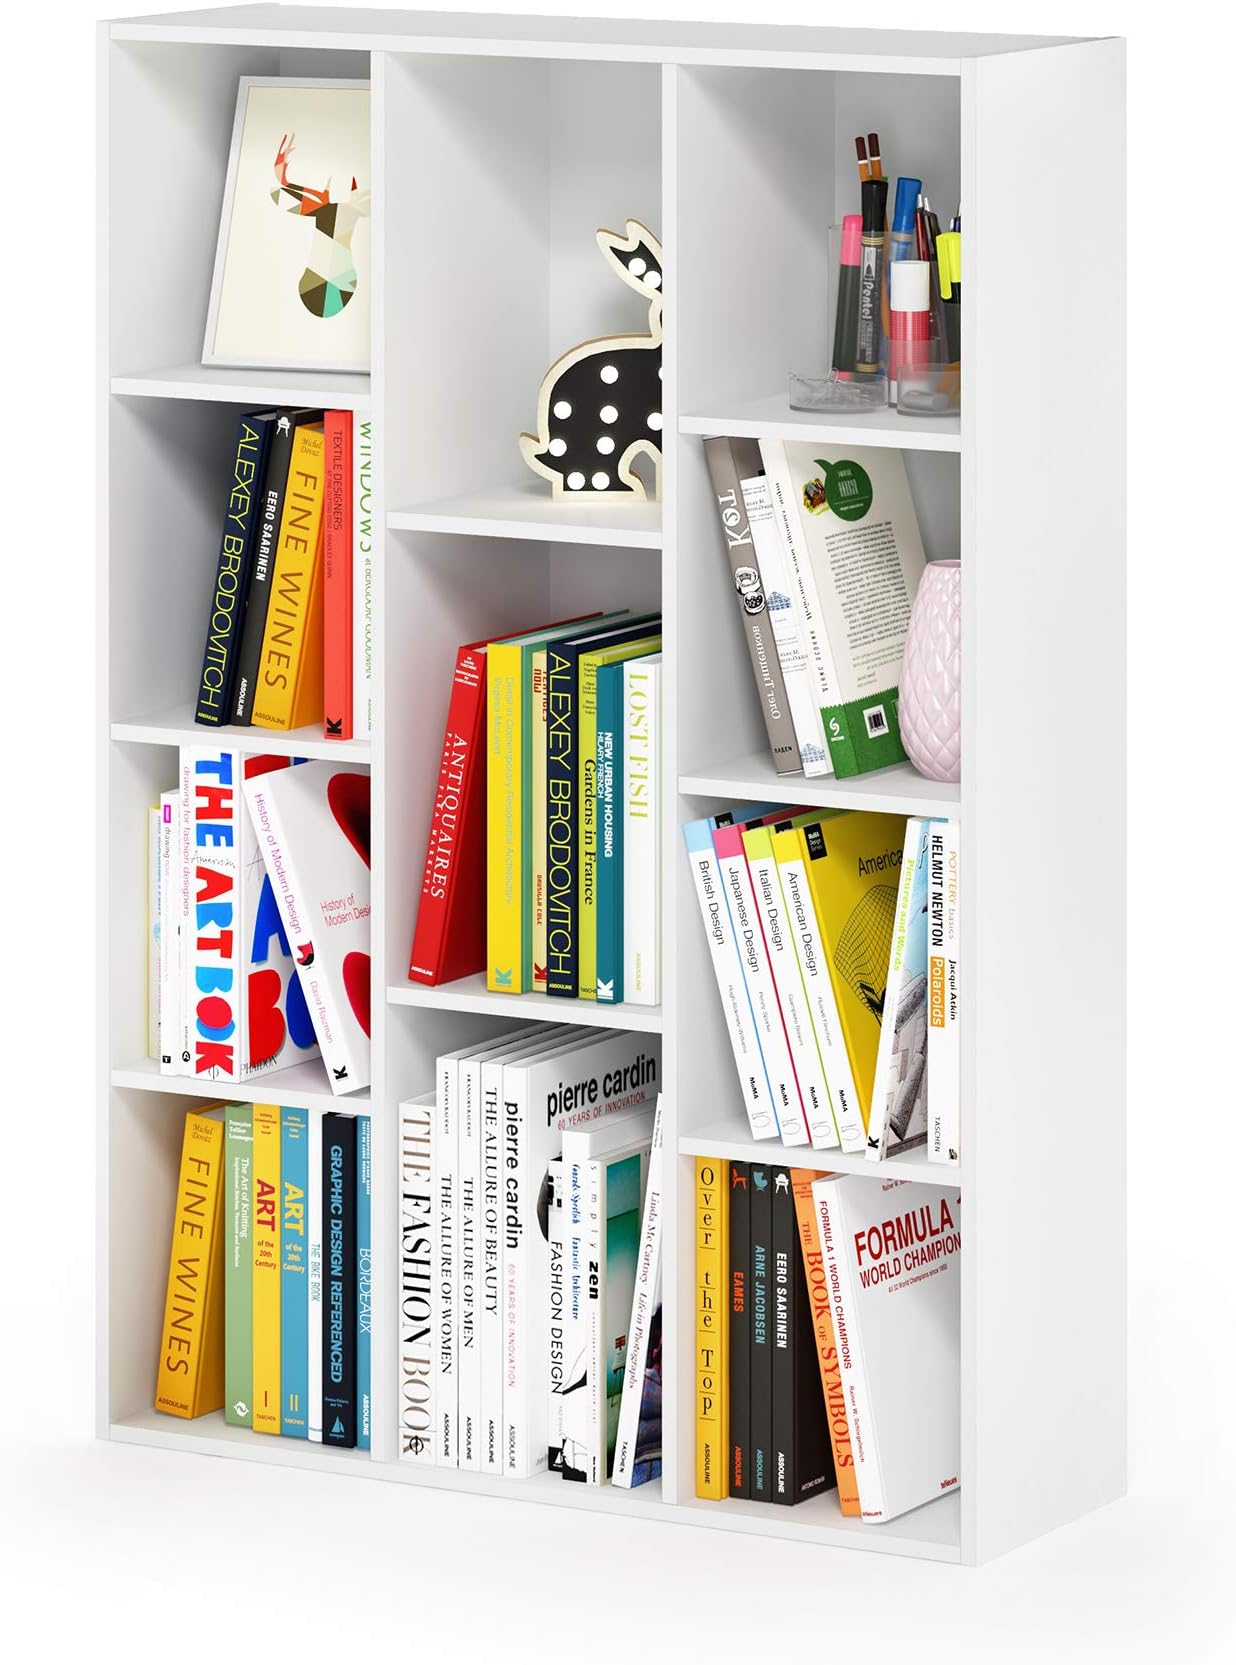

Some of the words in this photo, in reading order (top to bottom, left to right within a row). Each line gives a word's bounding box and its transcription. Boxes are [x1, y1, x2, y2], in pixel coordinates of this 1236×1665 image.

[862, 281, 874, 320] Pentel
[228, 423, 260, 530] ALEXEY
[333, 431, 342, 470] TEXTILE
[264, 490, 278, 525] EERO
[285, 470, 318, 554] FINE
[333, 473, 342, 530] DESIGNERS
[256, 528, 274, 582] SAARINEN
[200, 534, 244, 708] BRODOVITCH
[264, 572, 303, 690] WINES
[254, 712, 286, 726] ASSOULINE
[550, 652, 571, 770] ALEXEY
[629, 674, 648, 747] LOST
[604, 732, 613, 759] NEW
[195, 752, 233, 847] THE
[585, 759, 596, 829] Gardens
[604, 762, 613, 801] URBAN
[629, 756, 648, 818] FISH
[430, 734, 468, 899] ANTIQUAIRES
[585, 831, 596, 845] in
[604, 804, 613, 857] HOUSING
[254, 793, 271, 833] History
[267, 835, 277, 846] of
[272, 849, 289, 894] Modern
[285, 894, 302, 934] Design
[550, 780, 571, 974] BRODOVITCH
[585, 851, 596, 905] France
[902, 858, 915, 909] Pictures
[932, 835, 943, 887] HELMUT
[195, 865, 233, 959] ART
[320, 897, 347, 913] History
[347, 893, 355, 906] of
[699, 860, 715, 900] British
[708, 902, 724, 945] Design
[728, 867, 749, 927] Japanese
[744, 929, 760, 973] Design
[759, 869, 773, 905] Italian
[767, 908, 784, 951] Design
[788, 872, 808, 931] American
[801, 933, 818, 976] Design
[932, 892, 943, 947] NEWTON
[932, 958, 943, 1026] Polaroids
[949, 959, 957, 991] Jacqui
[485, 1088, 497, 1126] THE
[547, 1077, 598, 1127] pierre
[603, 1054, 656, 1098] cardin
[558, 1118, 565, 1131] 60
[568, 1110, 591, 1127] YEARS
[593, 1107, 602, 1119] OF
[605, 1091, 646, 1114] INNOVATION
[750, 1076, 759, 1099] MoMA
[780, 1084, 789, 1106] MoMA
[810, 1086, 819, 1109] MoMA
[839, 1089, 848, 1112] MoMA
[403, 1111, 431, 1182] THE
[505, 1101, 523, 1169] pierre
[330, 1145, 343, 1215] GRAPHIC
[441, 1174, 452, 1208] THE
[464, 1177, 473, 1212] THE
[485, 1131, 497, 1204] ALLURE
[181, 1157, 210, 1239] FINE
[240, 1204, 249, 1238] Knitting
[241, 1192, 249, 1201] of
[257, 1179, 275, 1232] ART
[284, 1182, 304, 1236] ART
[485, 1209, 497, 1233] OF
[506, 1178, 522, 1249] cardin
[649, 1191, 660, 1222] Linda
[701, 1167, 715, 1245] Over
[330, 1219, 343, 1276] DESIGN
[441, 1212, 452, 1278] ALLURE
[464, 1215, 473, 1280] ALLURE
[801, 1222, 810, 1245] THE
[854, 1198, 954, 1266] FORMULA
[860, 1258, 901, 1289] WORLD
[904, 1232, 961, 1271] CHAMPION
[255, 1260, 277, 1270] Century
[402, 1193, 432, 1348] FASHION
[485, 1240, 497, 1315] BEAUTY
[551, 1241, 563, 1320] FASHION
[589, 1261, 599, 1299] zen
[755, 1245, 765, 1278] ARNE
[777, 1252, 787, 1283] EERO
[806, 1251, 832, 1320] BOOK
[819, 1200, 834, 1252] FORMULA
[829, 1263, 841, 1303] WORLD
[836, 1307, 852, 1370] CHAMPIONS
[166, 1257, 200, 1375] WINES
[360, 1248, 371, 1334] BORDEAUX
[441, 1282, 452, 1304] OF
[464, 1285, 473, 1307] OF
[638, 1292, 647, 1312] Life
[703, 1272, 712, 1328] the
[734, 1271, 744, 1313] EAMES
[755, 1283, 765, 1344] JACOBSEN
[777, 1287, 787, 1348] SAARINEN
[330, 1281, 343, 1383] REFERENCED
[441, 1309, 452, 1374] WOMEN
[464, 1311, 473, 1348] MEN
[629, 1326, 643, 1389] Photographs
[818, 1326, 828, 1341] OF
[551, 1328, 563, 1395] DESIGN
[701, 1349, 714, 1416] Top
[158, 1397, 189, 1411] ASSOULINE
[402, 1356, 431, 1456] BOOK
[821, 1346, 854, 1468] SYMBOLS
[619, 1441, 628, 1473] TASCHEN
